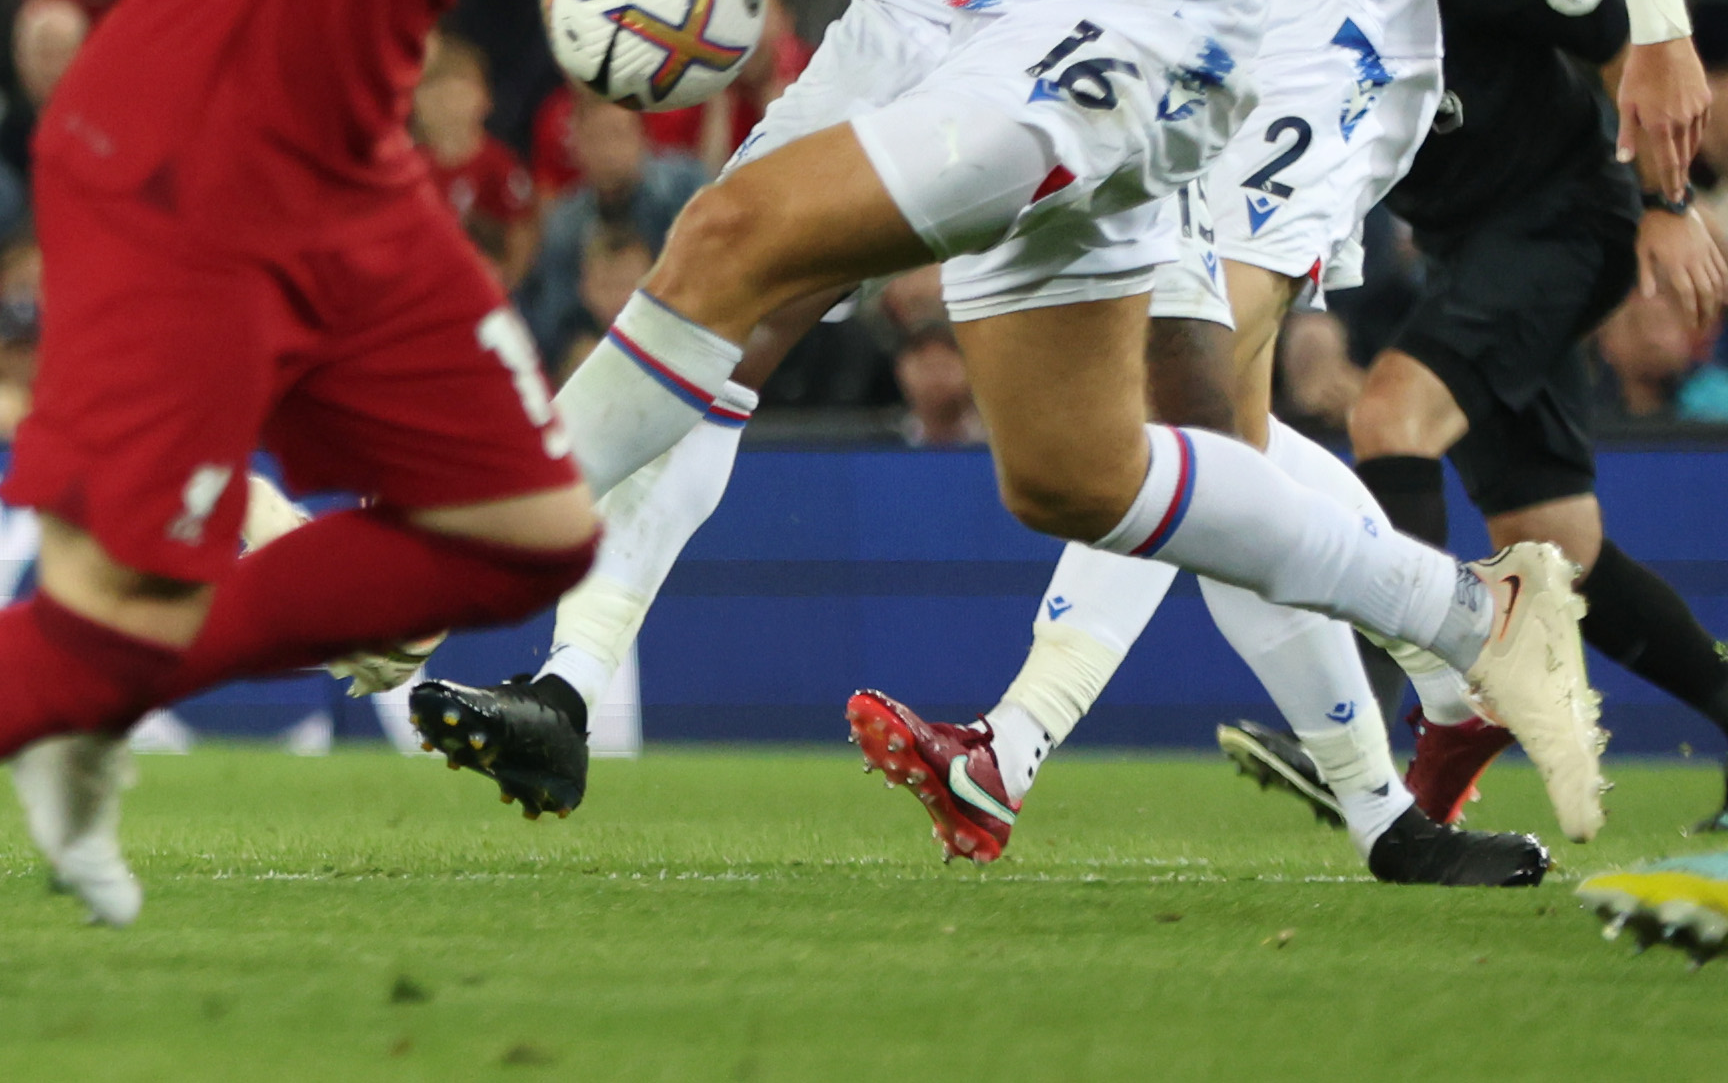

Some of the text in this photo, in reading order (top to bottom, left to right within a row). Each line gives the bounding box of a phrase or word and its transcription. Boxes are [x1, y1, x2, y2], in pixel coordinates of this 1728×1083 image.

[1024, 19, 1143, 111] 16
[1240, 116, 1312, 200] 2
[476, 305, 572, 460] 1
